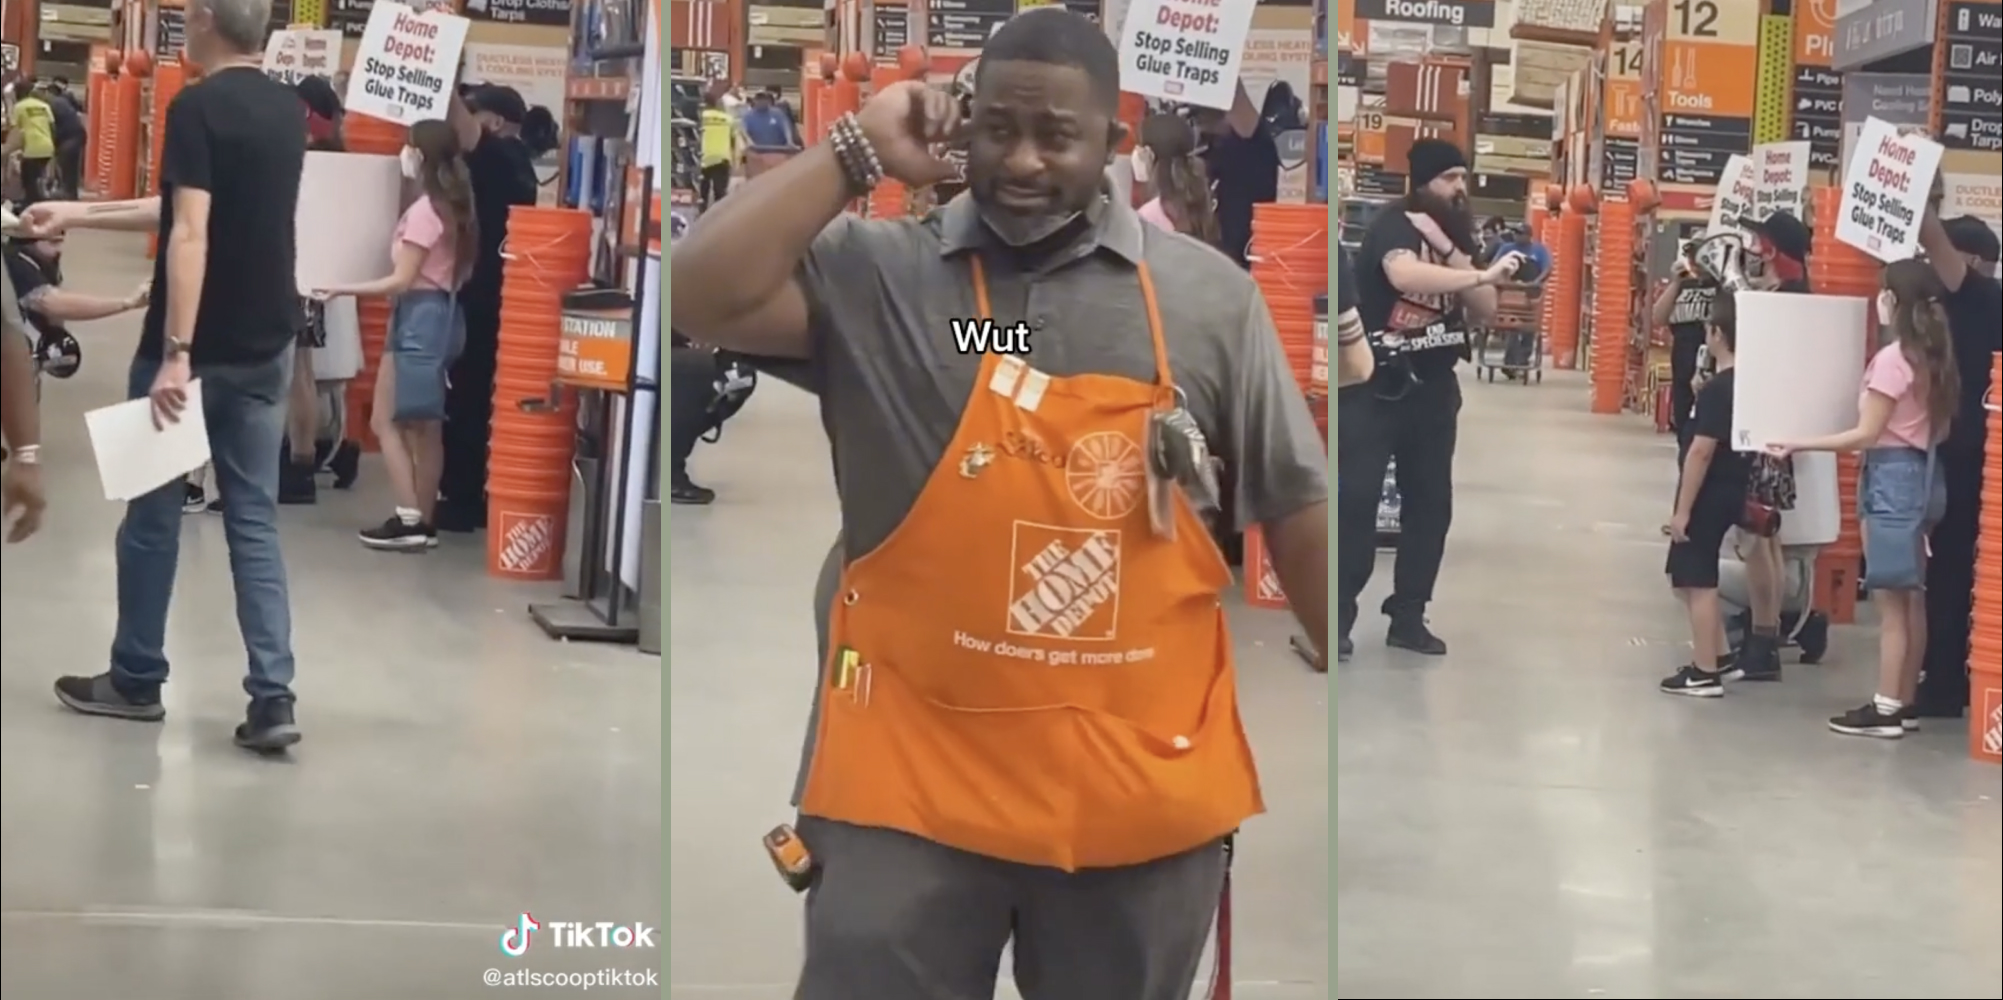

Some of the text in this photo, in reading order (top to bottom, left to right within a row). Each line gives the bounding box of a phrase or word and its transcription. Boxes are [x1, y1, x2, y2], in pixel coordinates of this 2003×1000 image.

[393, 12, 438, 39] Home
[1157, 5, 1219, 34] Depot:
[1386, 0, 1464, 24] Roofing
[1674, 0, 1718, 36] 12
[384, 36, 435, 63] Depot:
[1135, 31, 1230, 66] Stop Selling
[1247, 40, 1275, 50] LESS
[1281, 52, 1311, 62] SYST
[1976, 51, 1998, 65] Air
[1136, 54, 1171, 76] Glue
[1176, 60, 1219, 86] Traps
[1614, 47, 1642, 75] 14
[365, 58, 443, 93] Stop Selling
[1817, 73, 1839, 85] Pipe
[365, 79, 394, 100] Glue
[398, 86, 433, 110] Traps
[1668, 90, 1712, 109] Tools
[1814, 100, 1837, 111] PVC
[1363, 113, 1382, 129] 19
[1610, 119, 1641, 132] Fast
[1878, 135, 1916, 166] Home
[1970, 133, 2002, 149] Tarp
[1765, 150, 1791, 165] Home
[1764, 168, 1792, 186] Depot:
[1868, 158, 1910, 193] Depot:
[1852, 182, 1914, 226] Stop Selling
[1851, 206, 1875, 230] Glue
[1877, 216, 1906, 244] Traps
[1021, 538, 1071, 581] THE
[1009, 530, 1119, 635] HOME
[1050, 571, 1119, 638] DEPOT
[953, 630, 992, 652] How
[994, 640, 1045, 661] doers
[1048, 650, 1077, 666] get
[1081, 652, 1123, 665] more
